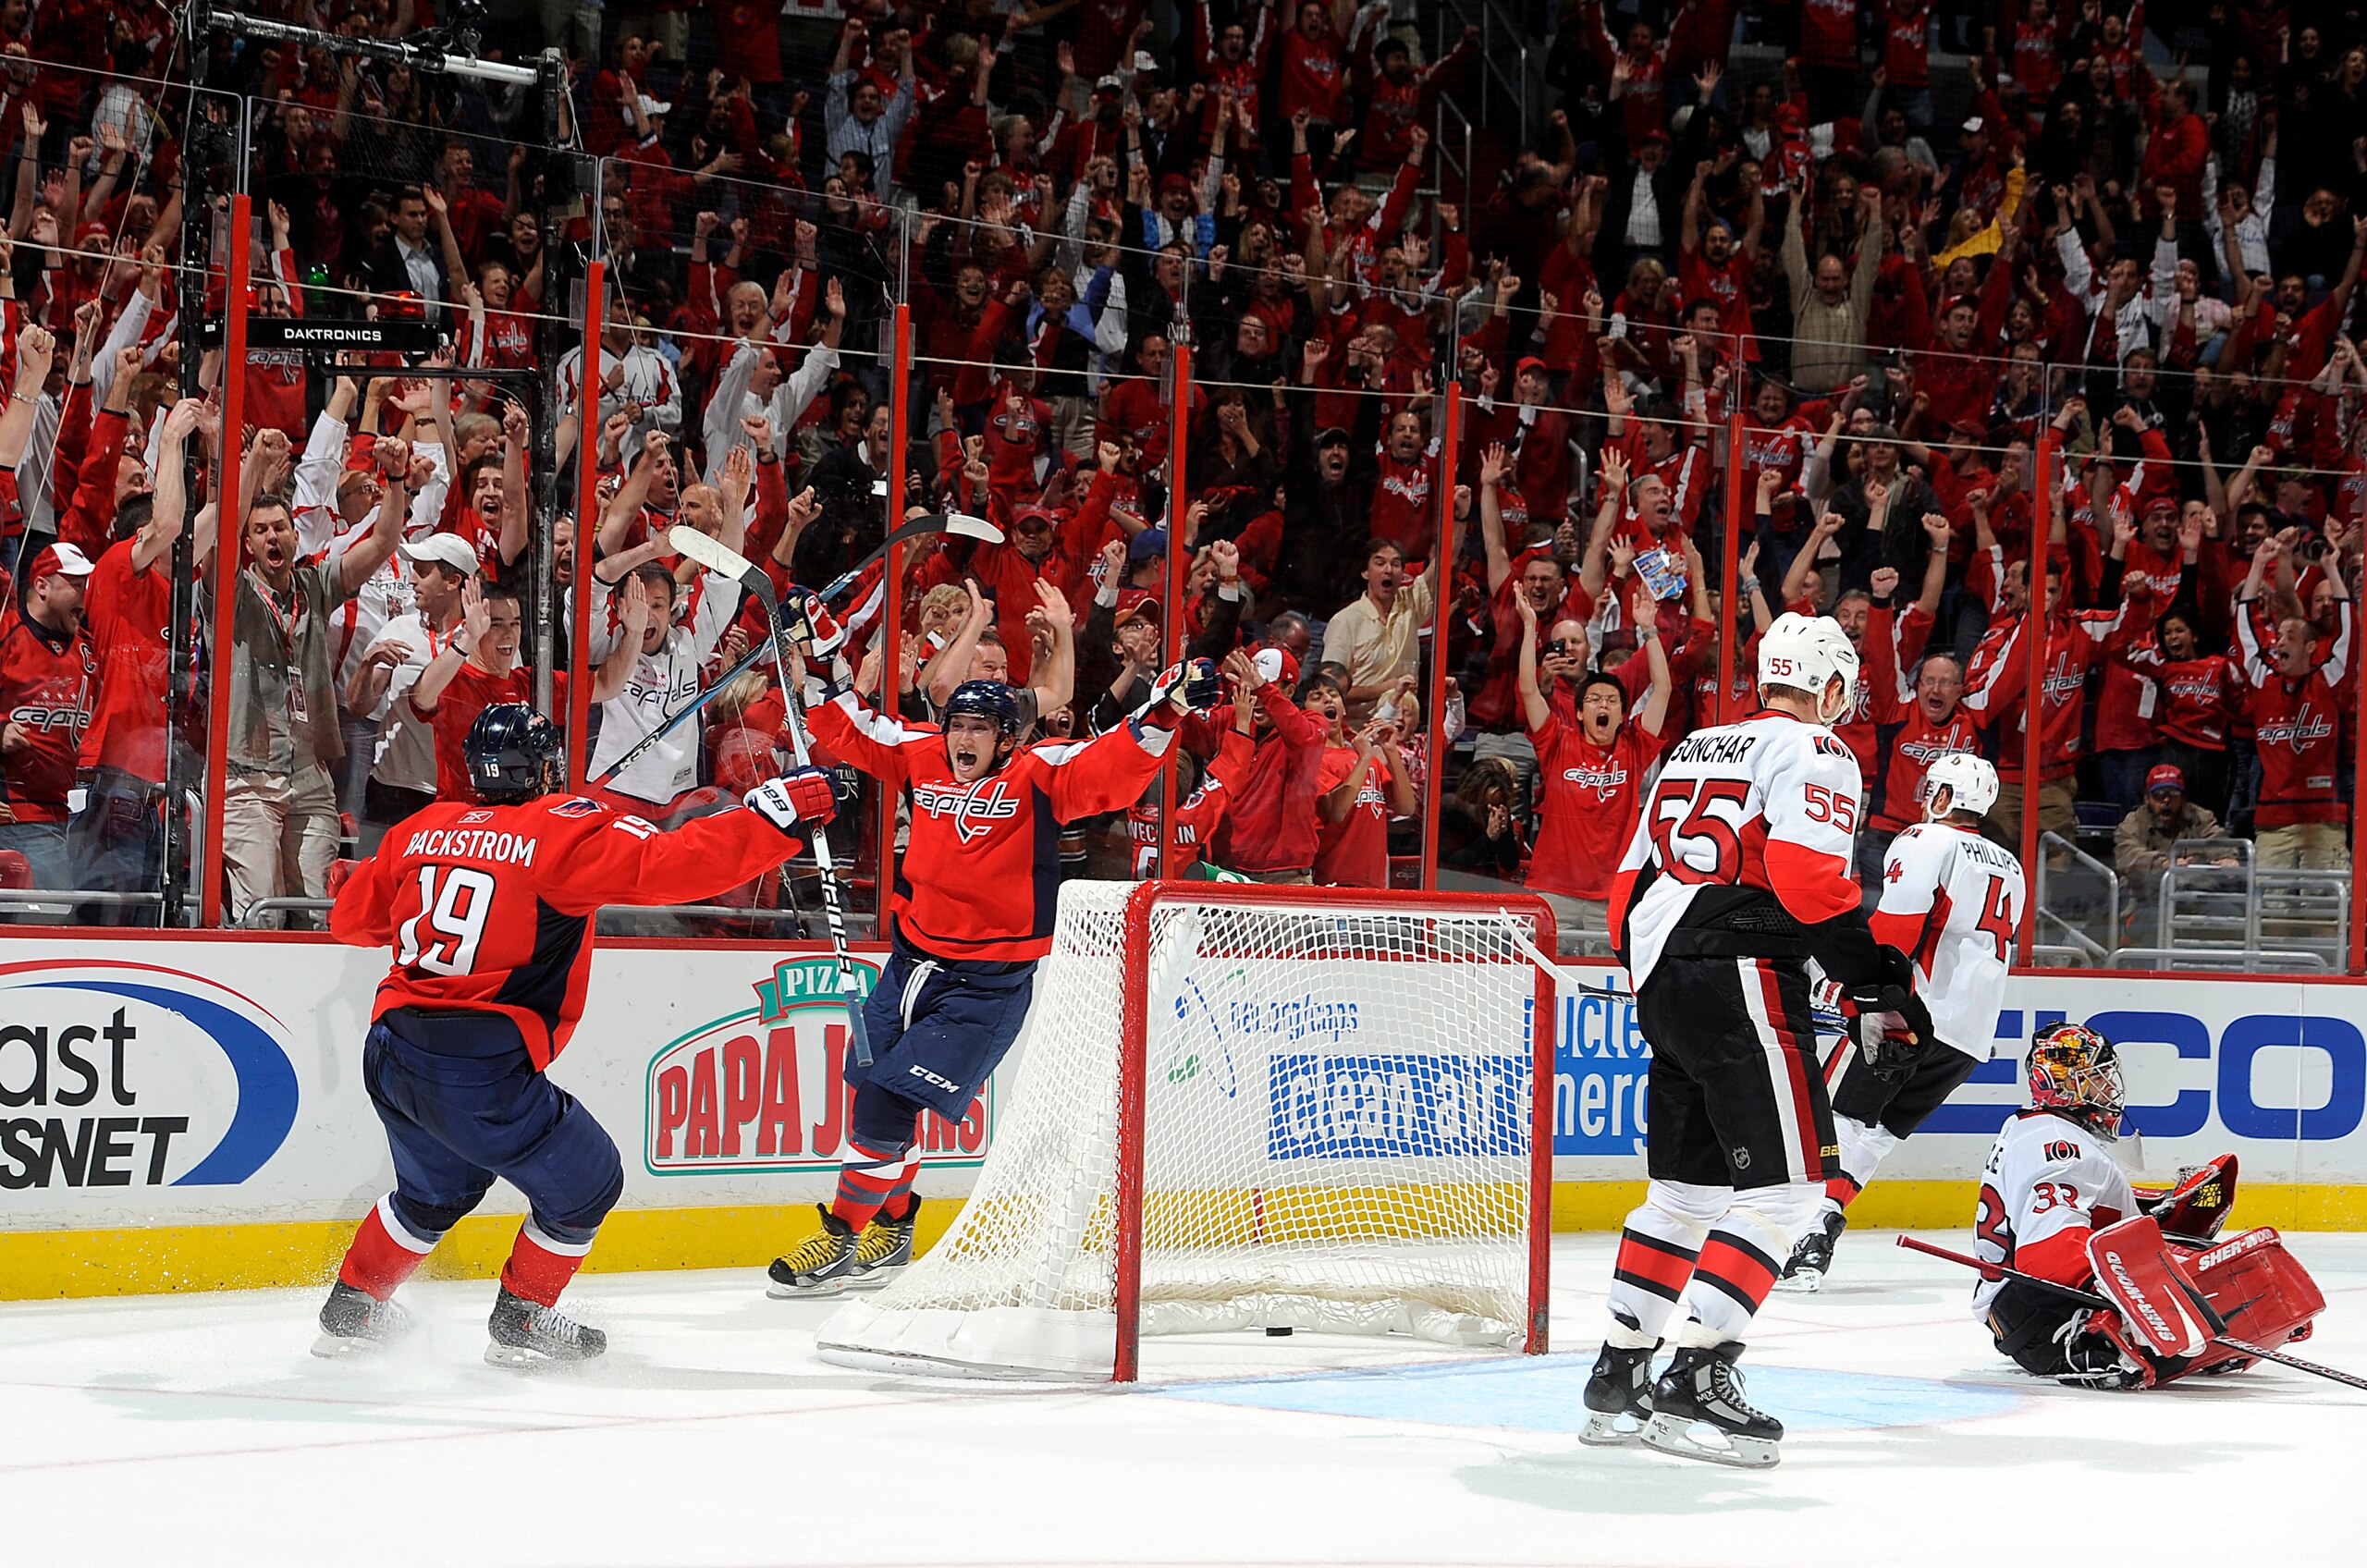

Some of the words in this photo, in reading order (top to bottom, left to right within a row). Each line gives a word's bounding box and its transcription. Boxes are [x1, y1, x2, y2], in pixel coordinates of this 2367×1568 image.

[284, 327, 382, 342] DAKTRONICS
[623, 655, 697, 722] apitals
[1770, 657, 1793, 676] 55
[484, 763, 500, 778] 19
[1670, 735, 1757, 764] GONCHAR
[912, 775, 1021, 845] capitals
[920, 782, 969, 795] WASHINGTON
[1804, 782, 1857, 835] 55
[401, 829, 537, 868] BACKSTROM
[1648, 778, 1753, 886] 55
[1883, 857, 1904, 884] 4
[1960, 841, 2020, 876] PHILLIPS
[395, 864, 497, 977] 19
[1974, 874, 2015, 963] 4
[0, 1006, 136, 1107] ast
[656, 1026, 803, 1158] PAPA
[909, 1064, 961, 1094] CCM
[2198, 1228, 2275, 1272] SHER-WOOD
[2105, 1251, 2177, 1342] SHER-WOOD
